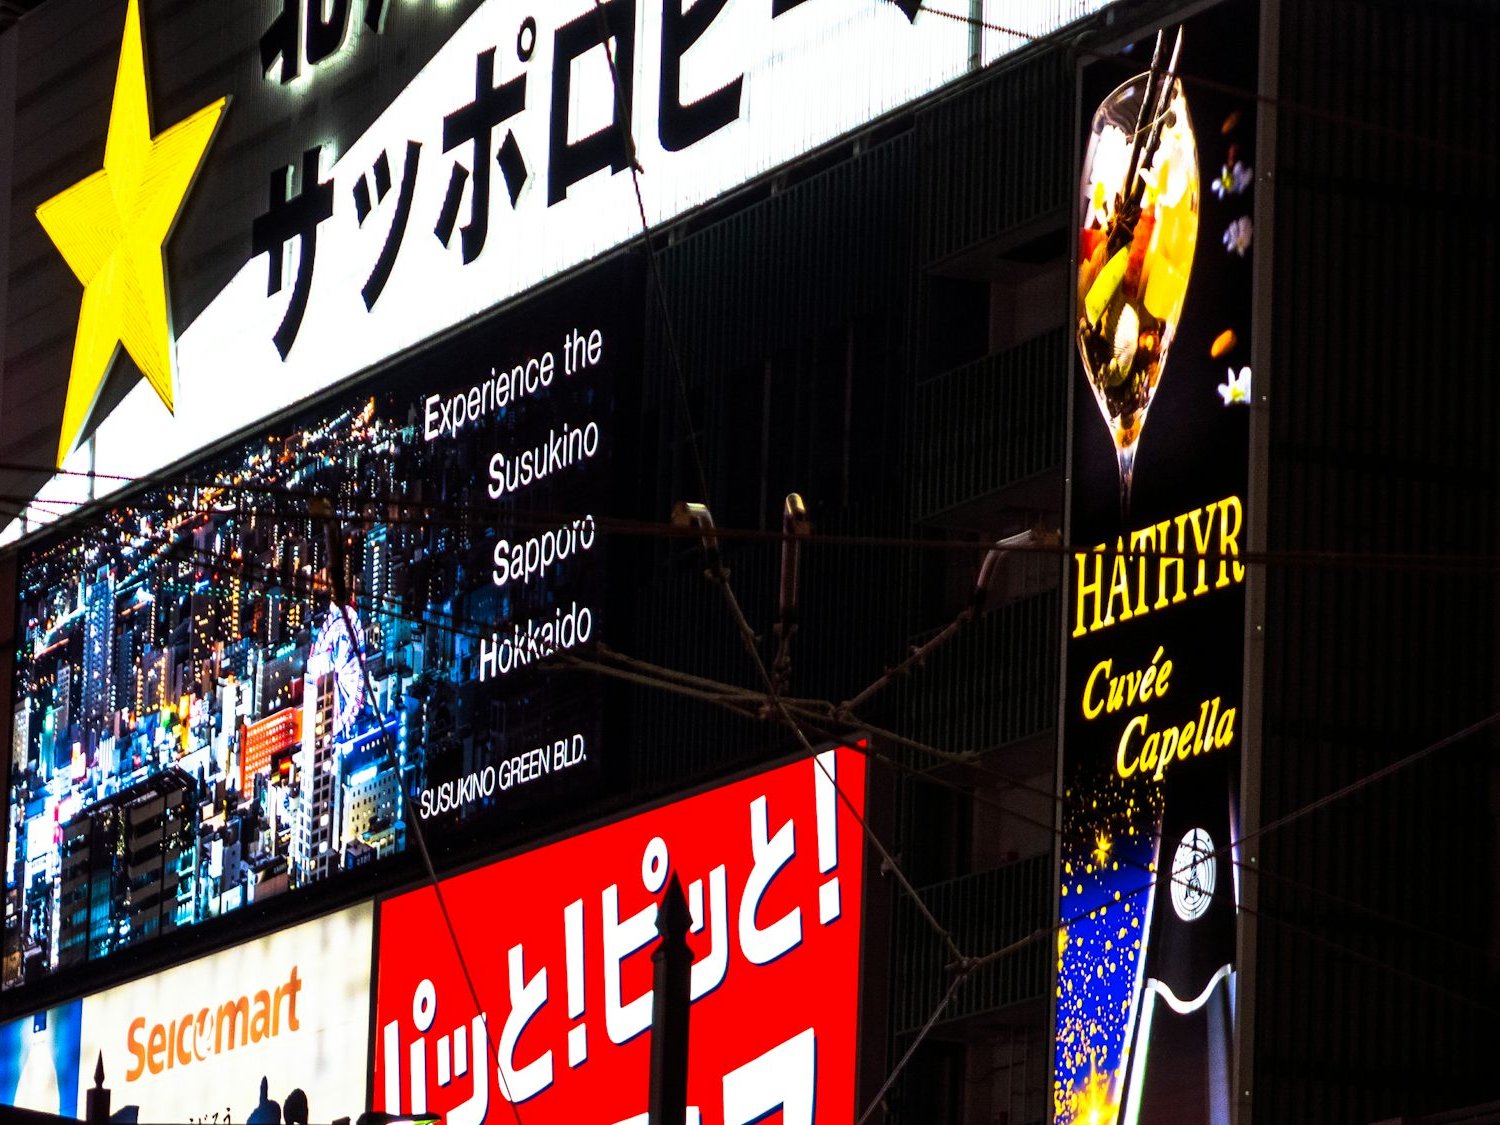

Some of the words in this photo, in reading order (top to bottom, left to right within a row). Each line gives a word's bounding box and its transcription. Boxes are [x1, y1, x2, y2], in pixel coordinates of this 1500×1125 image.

[424, 353, 554, 441] Experience
[562, 328, 602, 387] the
[487, 420, 599, 499] Susukino
[491, 514, 595, 587] Sapporo
[1072, 495, 1245, 638] HATHYR
[479, 602, 592, 683] Hokkaido
[1082, 646, 1173, 720] Cuvée
[420, 765, 494, 820] SUSUKINO
[498, 745, 551, 791] GREEN
[553, 734, 587, 771] BLD.
[1116, 697, 1236, 781] Capella
